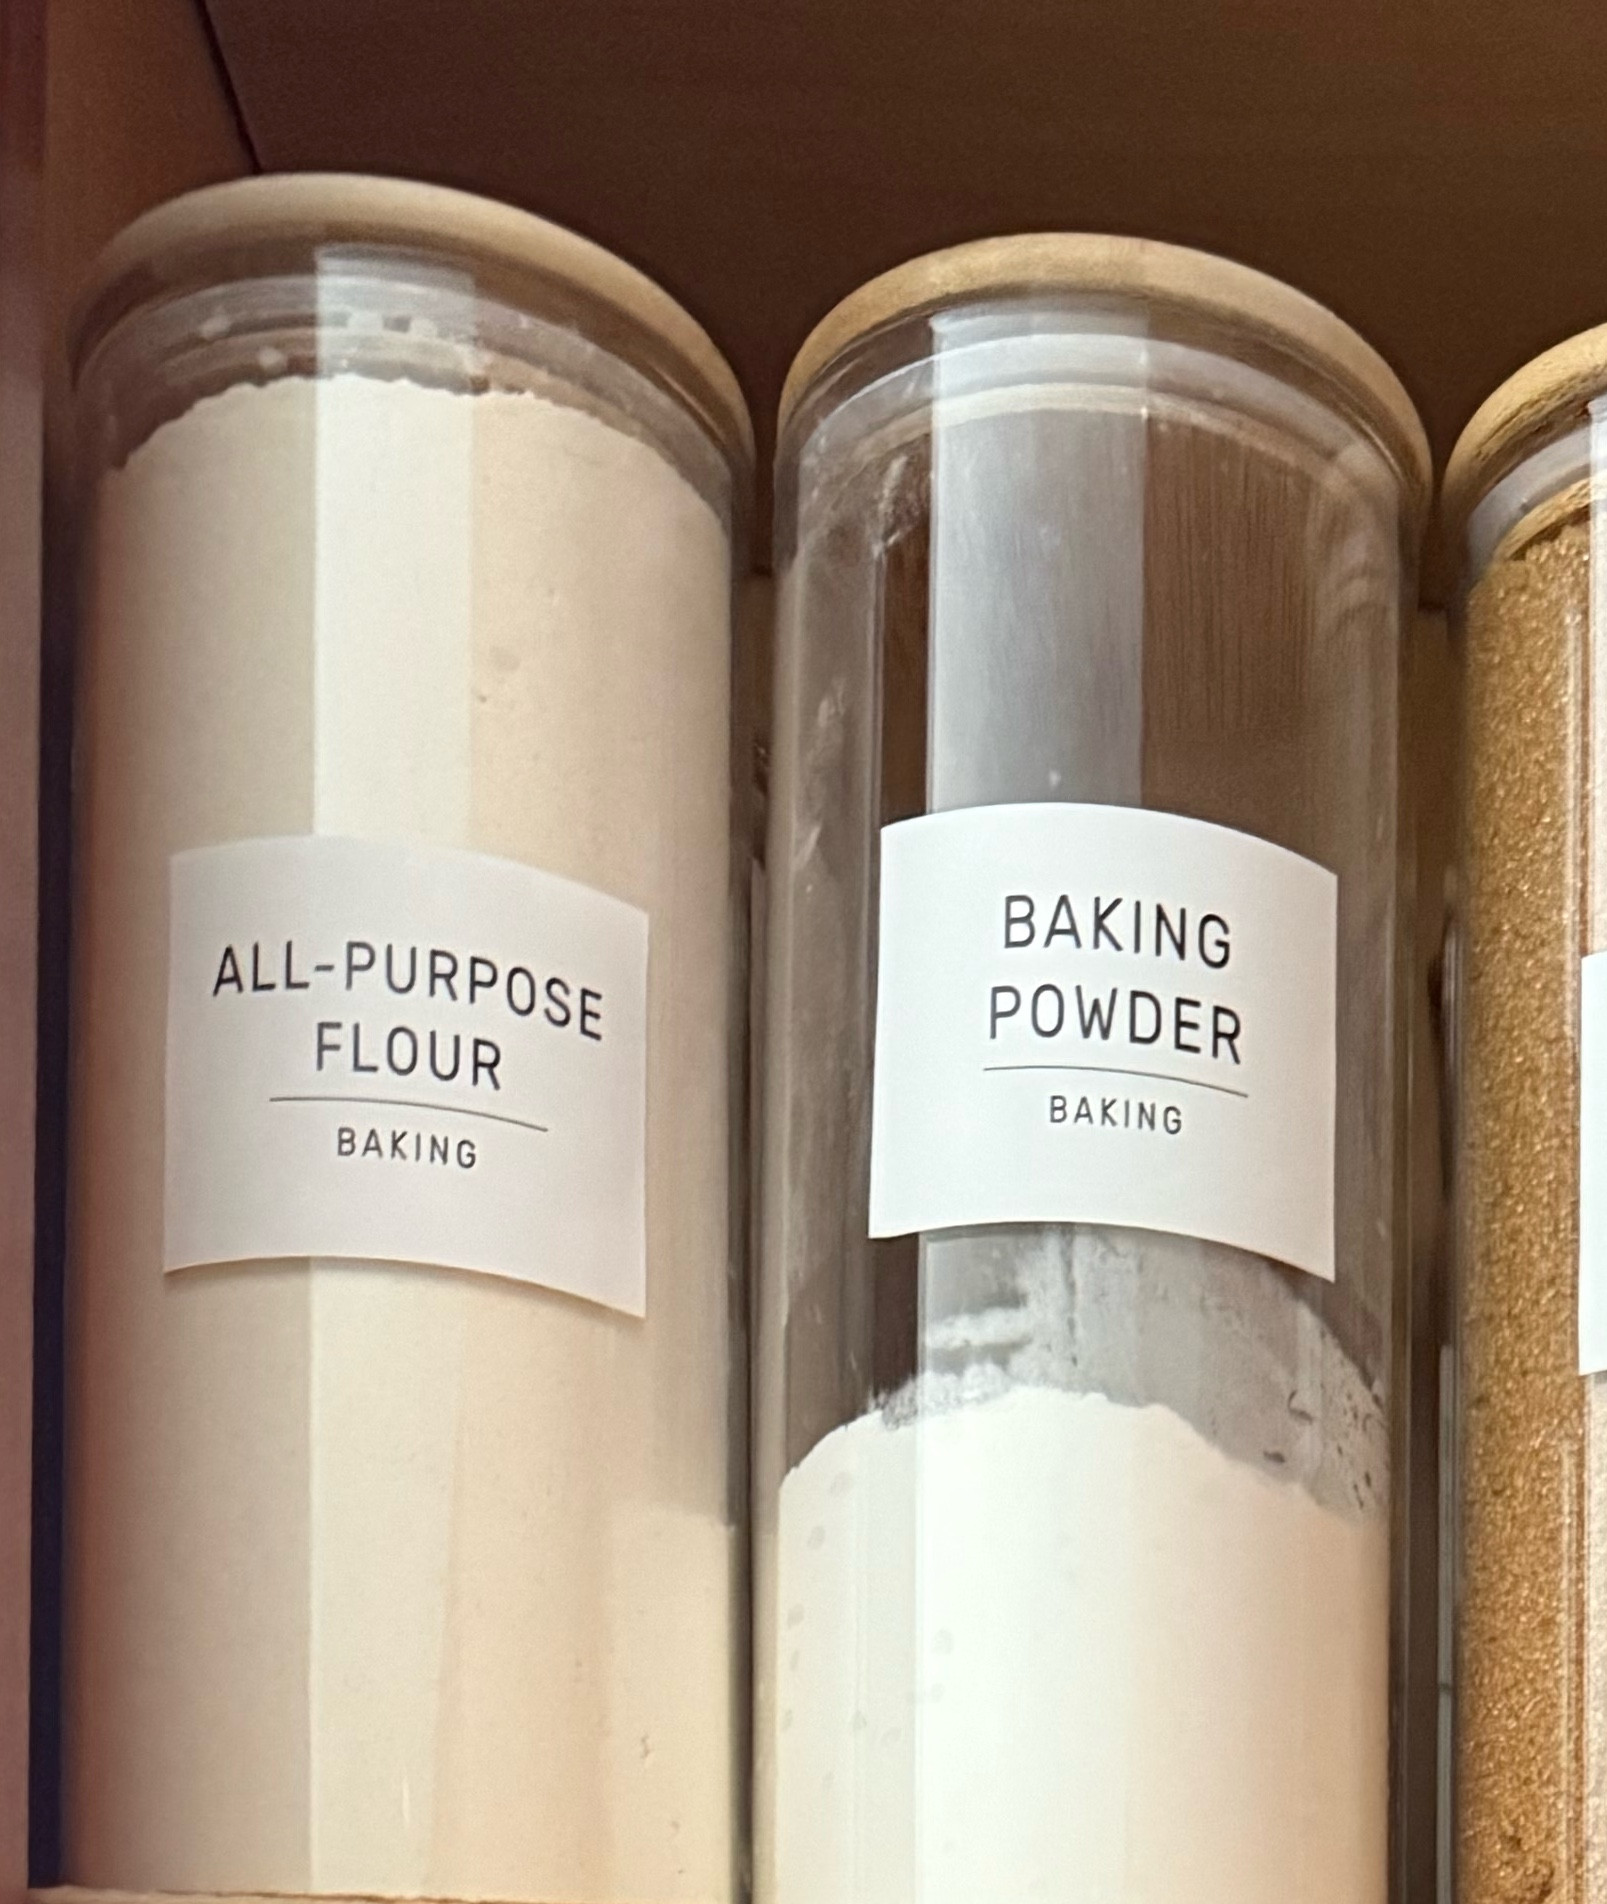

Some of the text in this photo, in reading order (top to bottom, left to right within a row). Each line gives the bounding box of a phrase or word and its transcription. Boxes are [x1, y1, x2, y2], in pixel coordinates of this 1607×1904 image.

[1004, 894, 1231, 970] BAKING
[212, 940, 603, 1043] ALL-PURPOSE
[987, 983, 1242, 1068] POWDER
[316, 1021, 502, 1091] FLOUR
[336, 1126, 477, 1170] BAKING
[1049, 1095, 1183, 1135] BAKING
